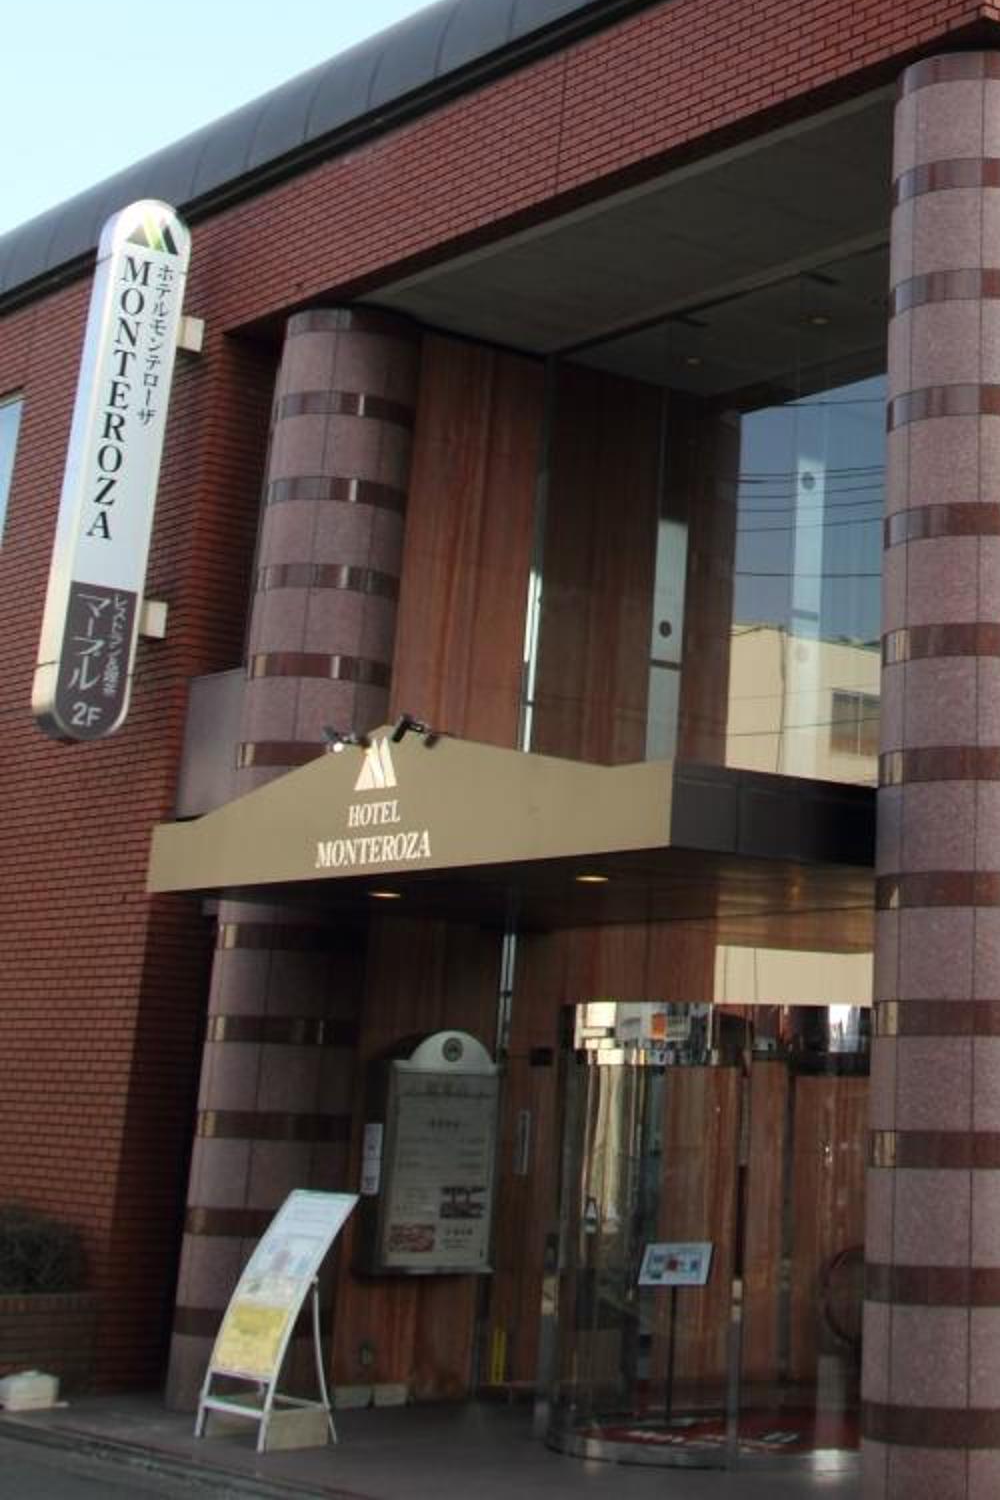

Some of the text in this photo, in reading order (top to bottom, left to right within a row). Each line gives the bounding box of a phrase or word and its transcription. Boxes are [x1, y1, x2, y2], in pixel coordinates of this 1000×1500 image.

[85, 256, 154, 541] MONTEROZA
[66, 592, 111, 691] マーブル
[70, 700, 102, 727] 2F
[347, 799, 401, 828] HOTEL
[314, 829, 431, 868] MONTEROZA
